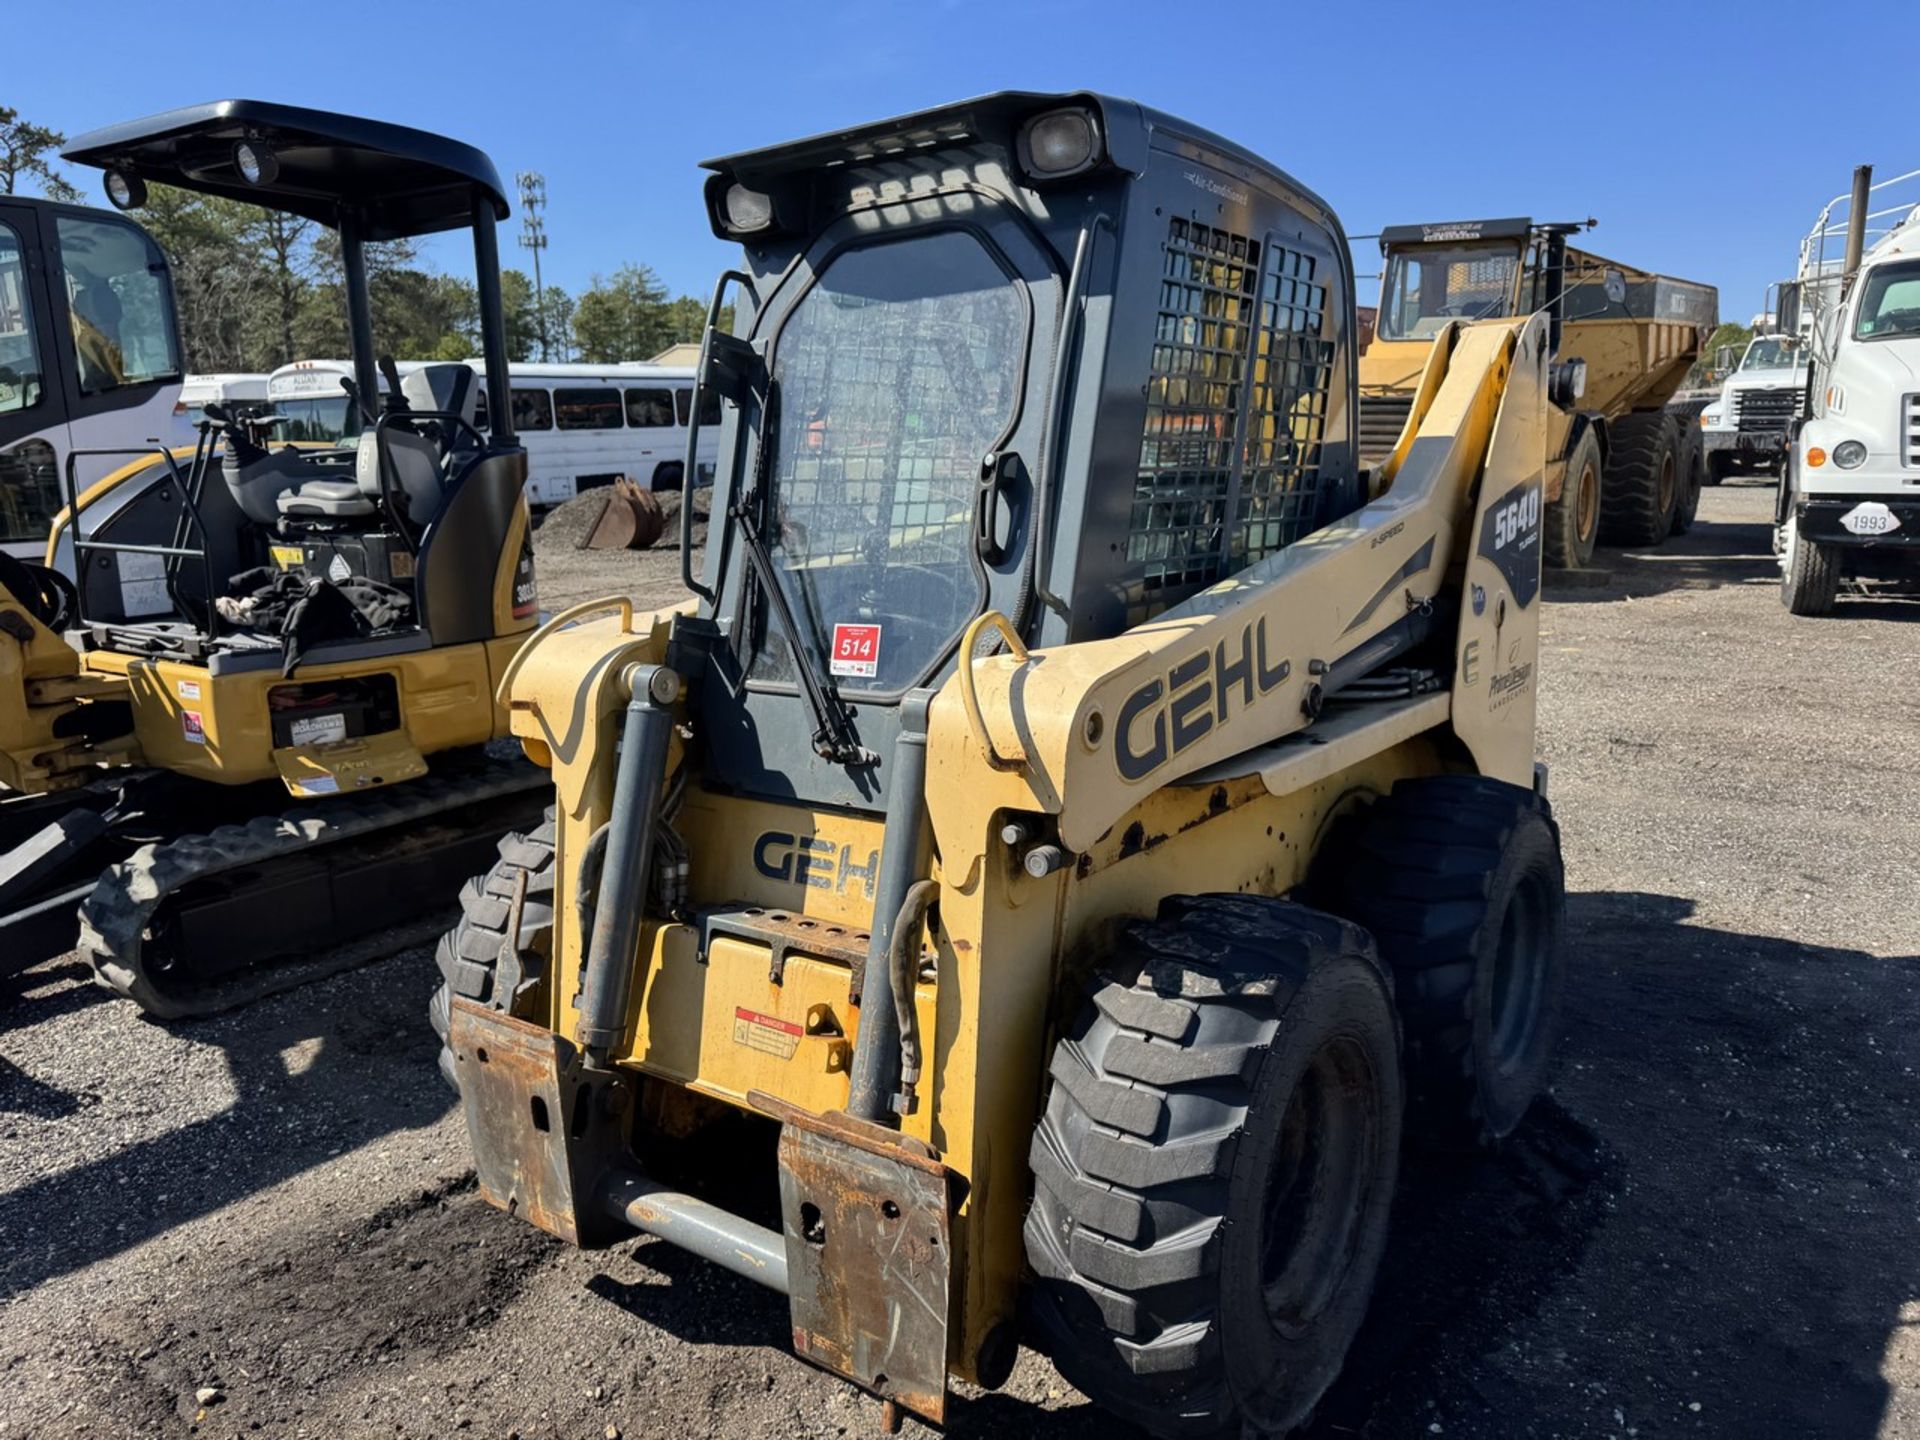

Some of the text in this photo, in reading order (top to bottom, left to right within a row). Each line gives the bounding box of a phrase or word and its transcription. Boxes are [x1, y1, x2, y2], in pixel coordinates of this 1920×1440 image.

[1495, 487, 1538, 550] 5640
[1853, 515, 1887, 530] 1993
[1371, 521, 1405, 549] 2-SPEED
[840, 638, 872, 657] 514
[1115, 615, 1290, 780] GEHL
[753, 831, 880, 899] GEH
[760, 1015, 786, 1030] DANGER
